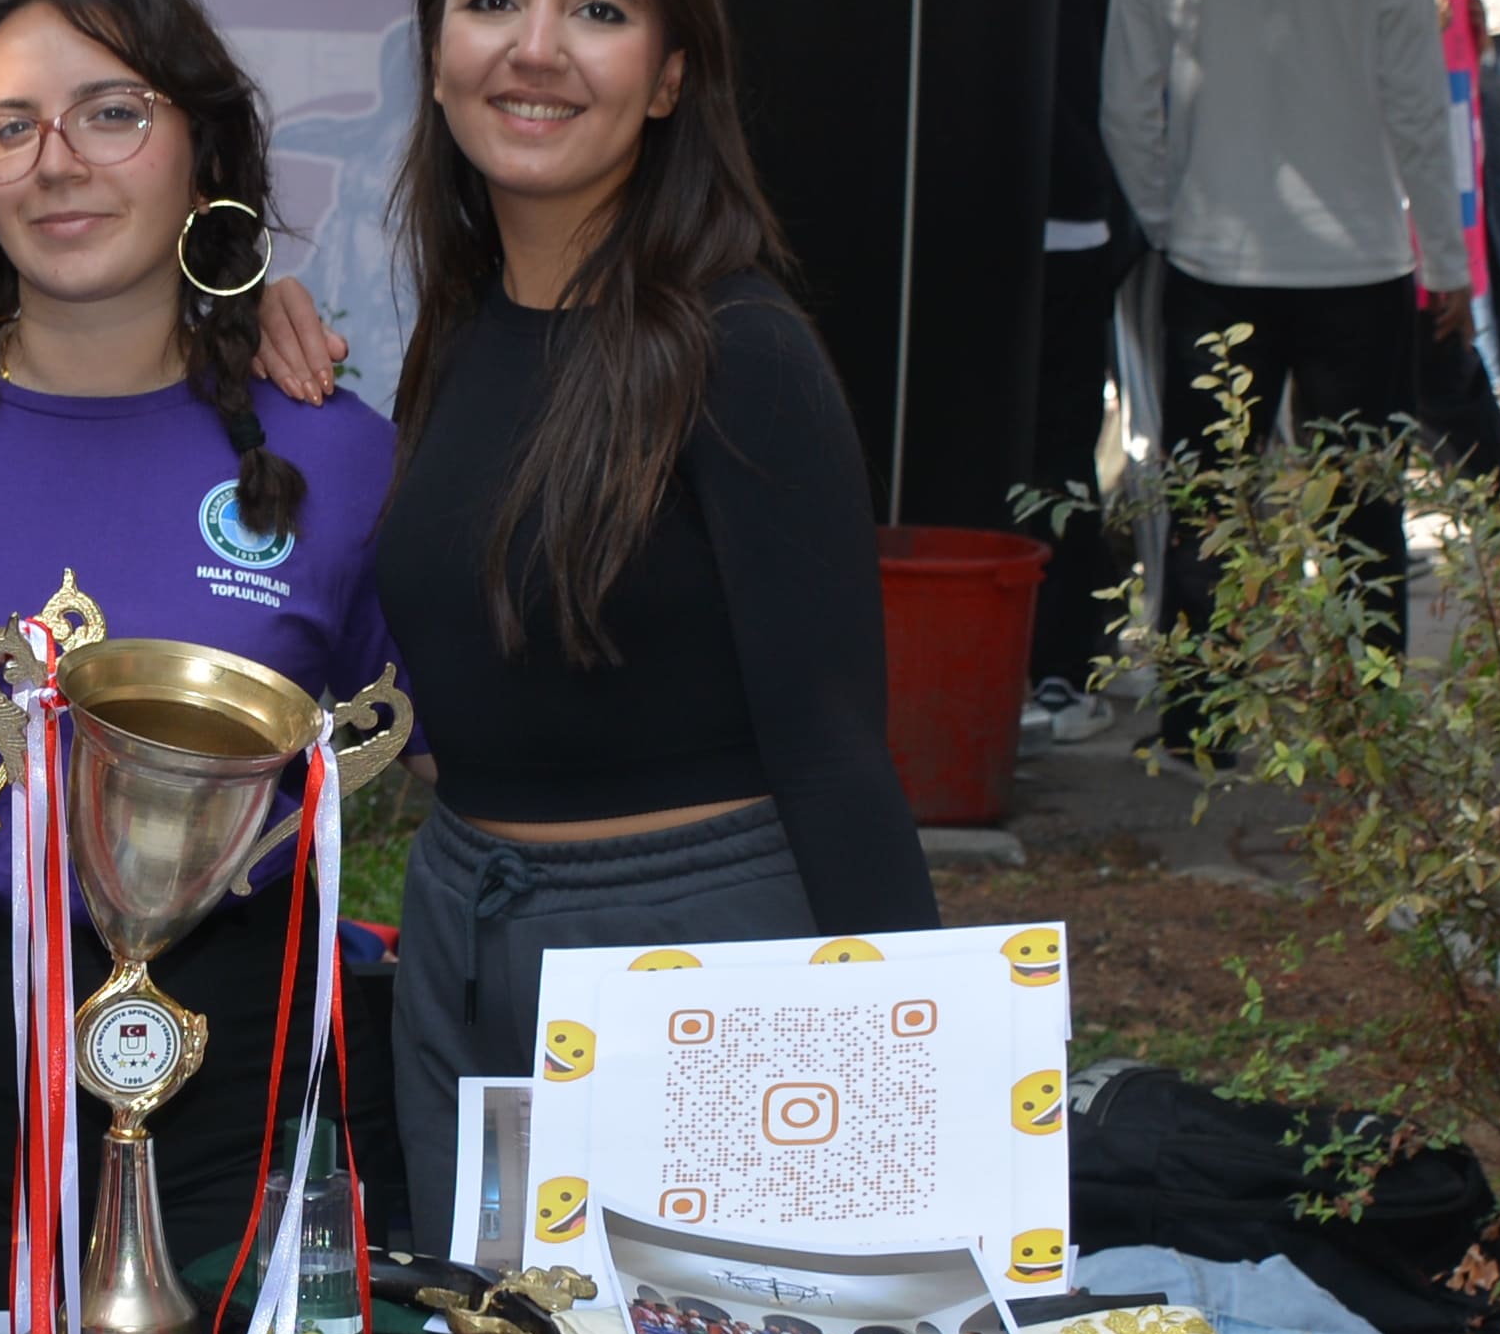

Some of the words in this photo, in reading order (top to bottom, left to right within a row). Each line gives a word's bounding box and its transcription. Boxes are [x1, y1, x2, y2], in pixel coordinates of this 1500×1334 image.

[196, 565, 234, 582] HALK
[233, 569, 292, 598] OYUNLARI
[208, 582, 282, 608] TOPLULUĞU
[127, 1009, 162, 1026] SPORLARI
